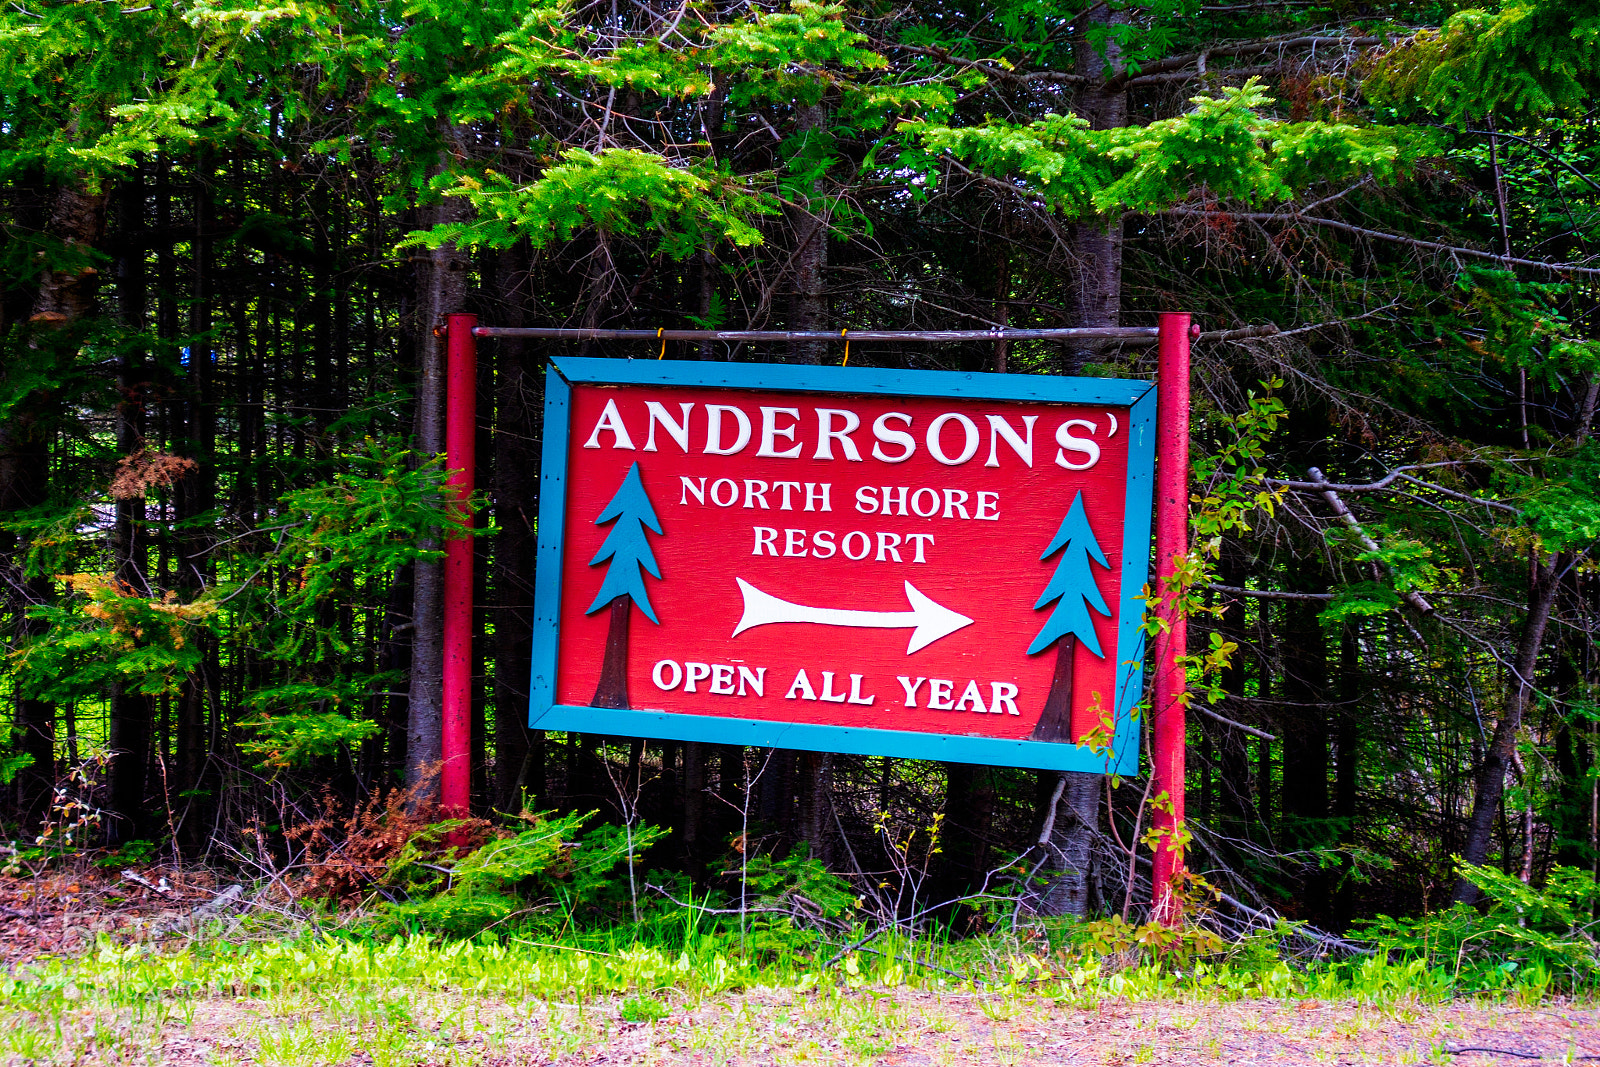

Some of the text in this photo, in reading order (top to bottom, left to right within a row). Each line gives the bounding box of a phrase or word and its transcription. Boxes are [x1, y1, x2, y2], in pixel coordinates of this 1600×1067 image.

[583, 398, 1119, 471] ANDERSONS'
[679, 475, 1001, 521] NORTH SHORE
[751, 526, 936, 564] RESORT
[652, 659, 1021, 716] OPEN ALL YEAR
